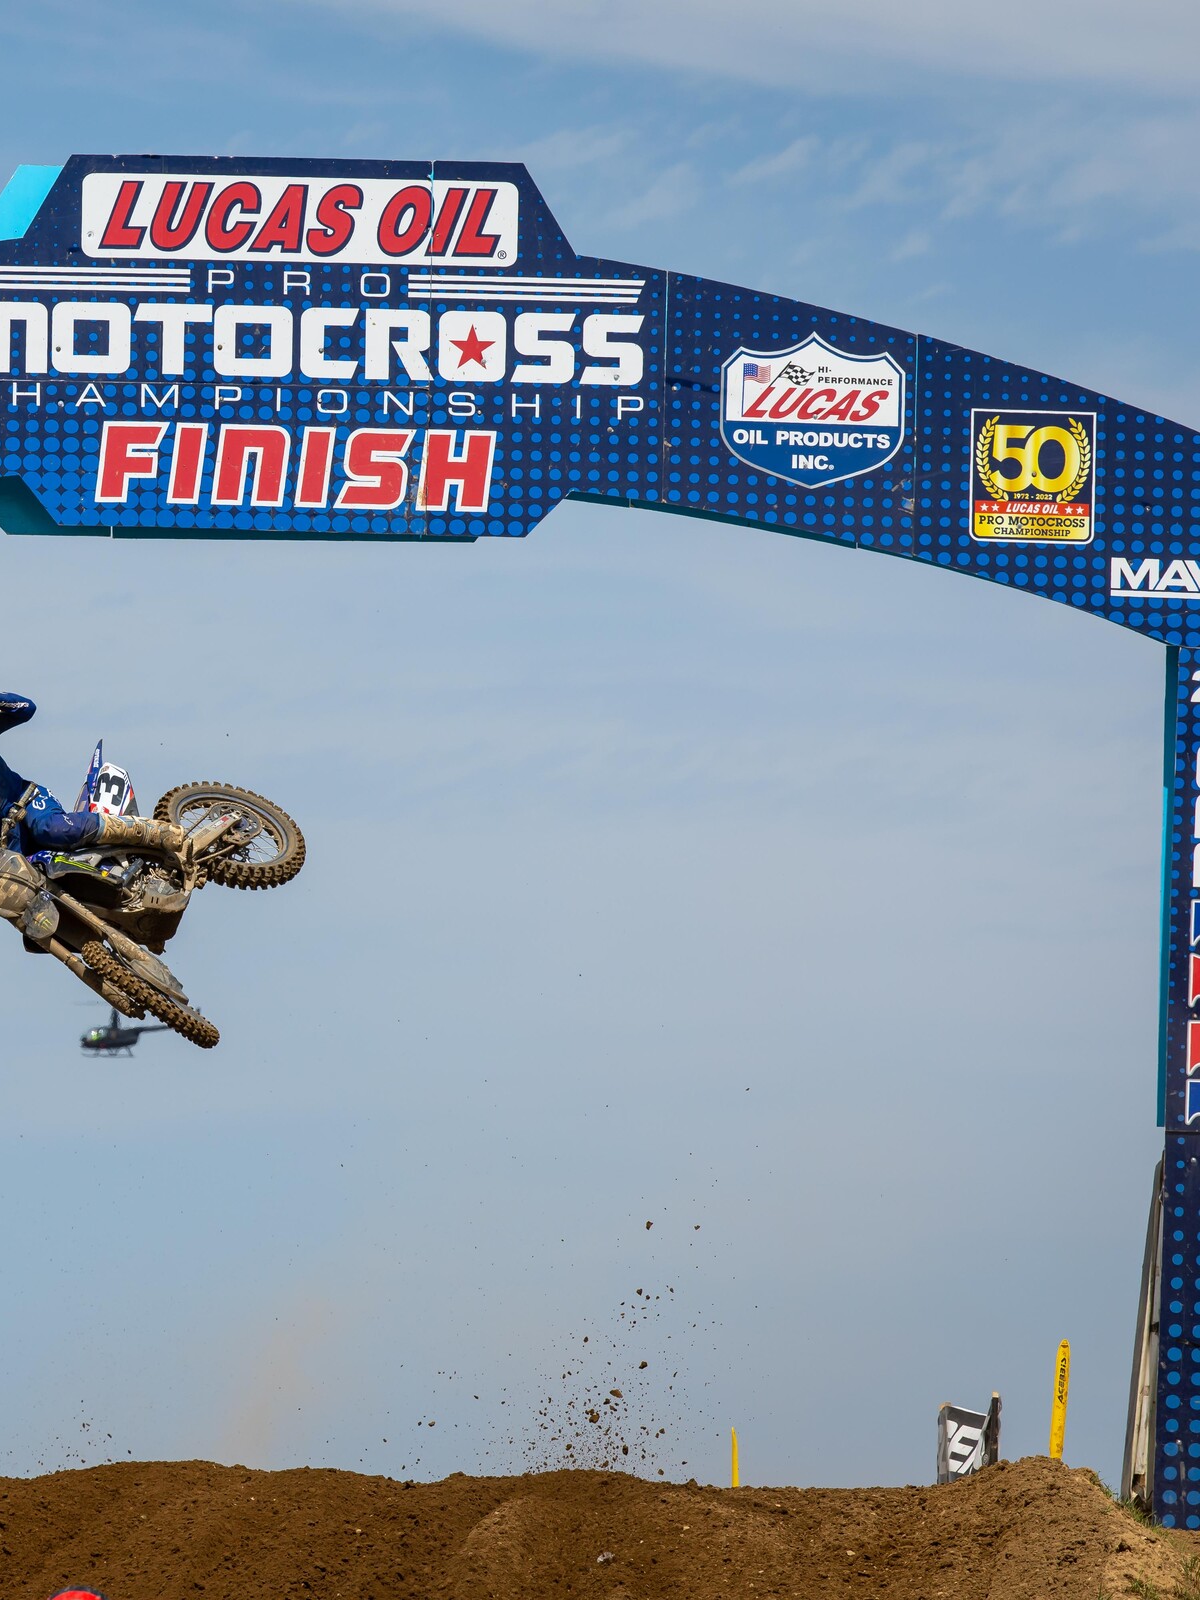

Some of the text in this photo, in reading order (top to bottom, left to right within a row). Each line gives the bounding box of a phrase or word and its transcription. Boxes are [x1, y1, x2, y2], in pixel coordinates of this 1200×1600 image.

[99, 180, 501, 259] LUCAS OIL
[208, 268, 392, 297] PRO
[818, 377, 893, 386] PERFORMANCE
[742, 387, 890, 422] LUCAS
[733, 429, 890, 449] OIL PRODUCTS
[95, 420, 497, 513] FINISH
[792, 454, 829, 470] INC.
[990, 425, 1081, 493] 50
[1013, 492, 1029, 500] 1972
[1006, 503, 1059, 514] LUCAS OIL
[979, 515, 1085, 528] PRO MOTOCROSS
[994, 527, 1071, 537] CHAMPIONSHIP
[93, 773, 126, 806] 3
[1057, 1357, 1067, 1404] ACERBIS
